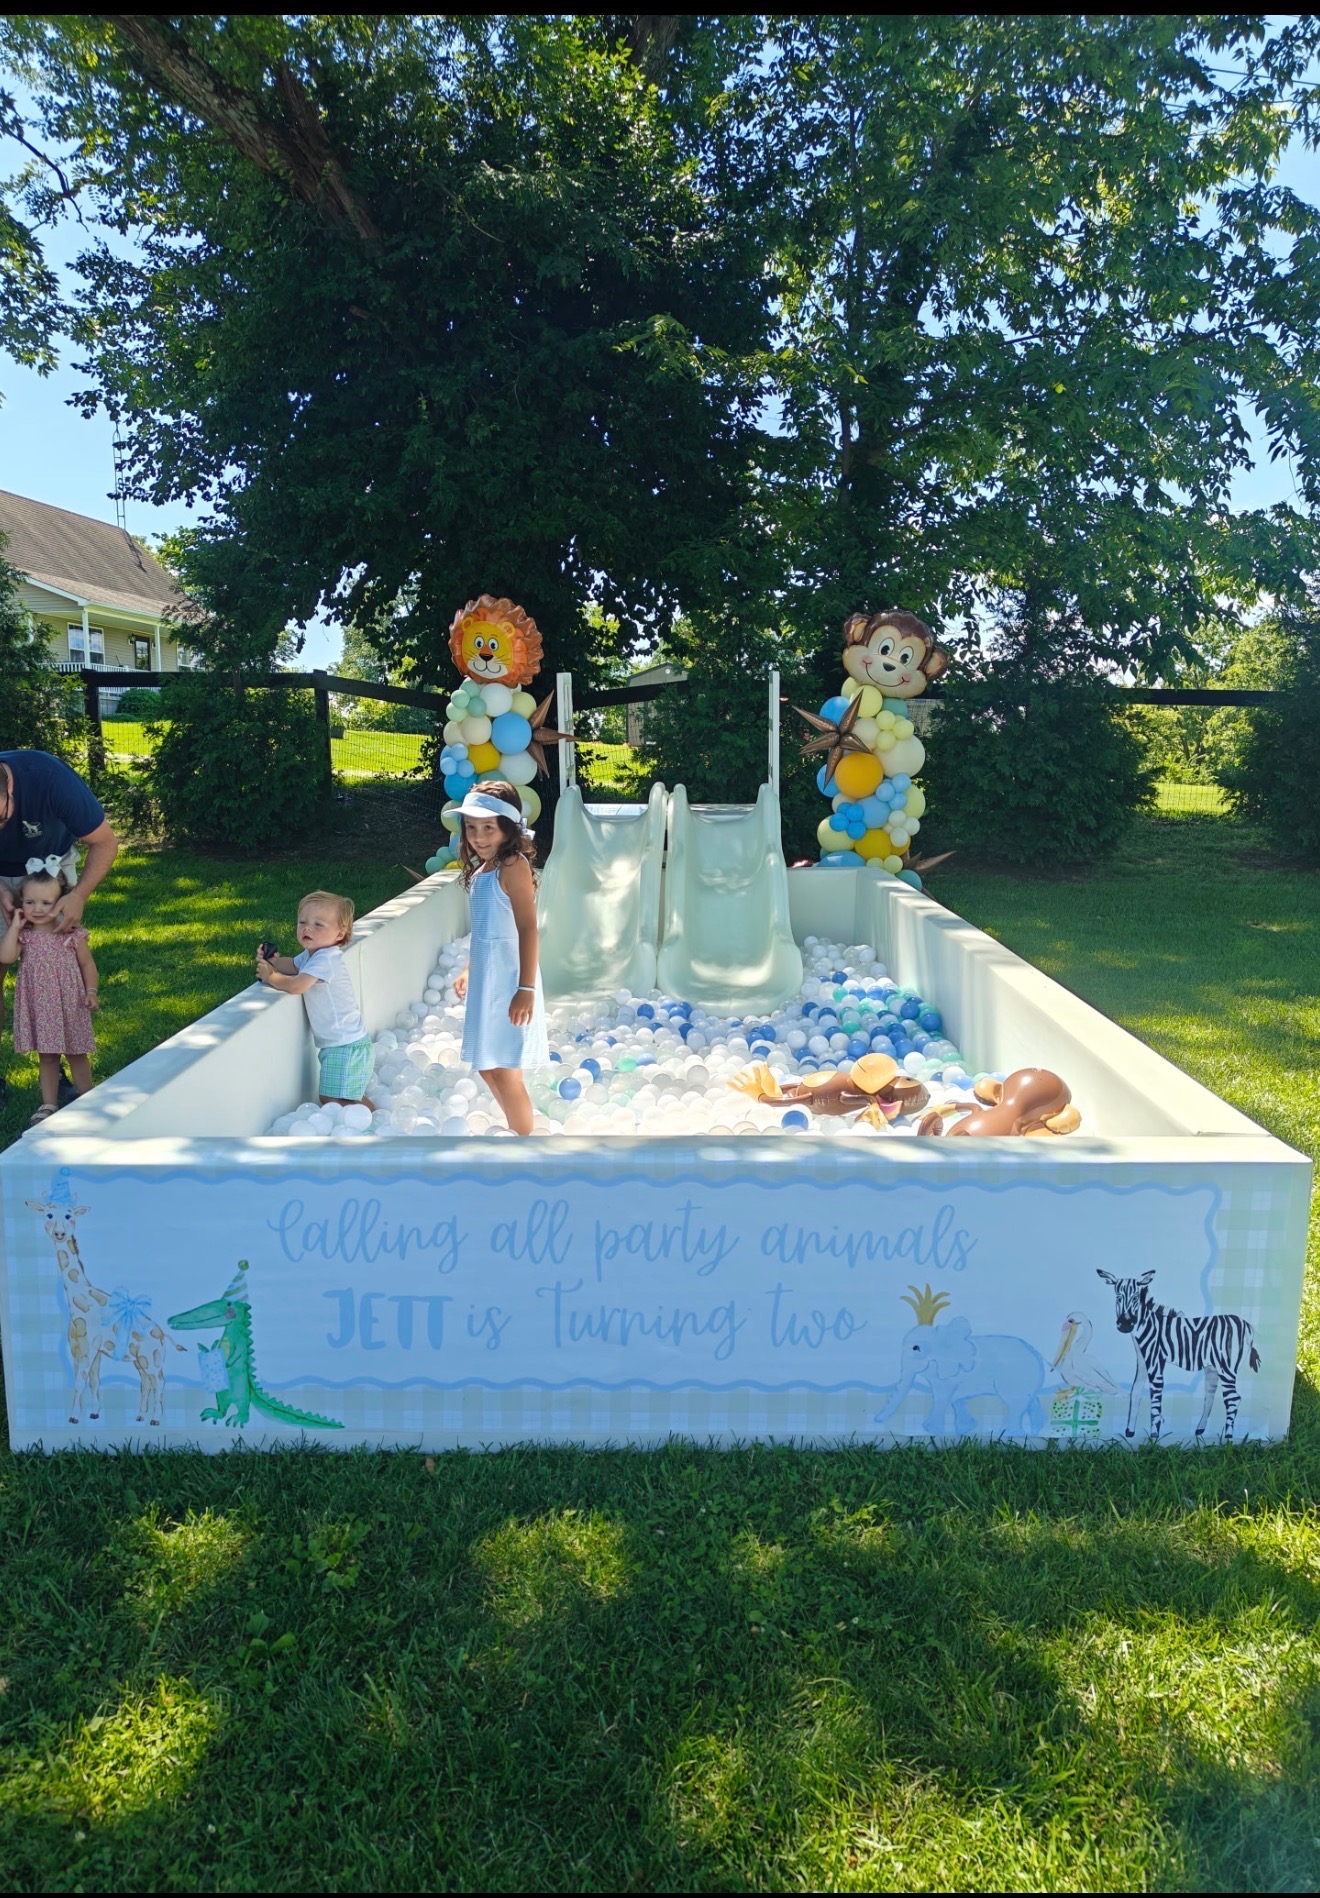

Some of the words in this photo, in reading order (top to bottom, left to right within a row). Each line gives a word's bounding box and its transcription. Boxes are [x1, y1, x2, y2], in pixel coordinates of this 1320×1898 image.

[266, 1198, 469, 1275] Calling
[489, 1198, 574, 1265] all
[594, 1200, 741, 1283] party
[760, 1203, 979, 1272] animals
[322, 1286, 455, 1351] JETT
[466, 1303, 512, 1351] is
[534, 1277, 747, 1361] Turning
[764, 1281, 868, 1350] two
